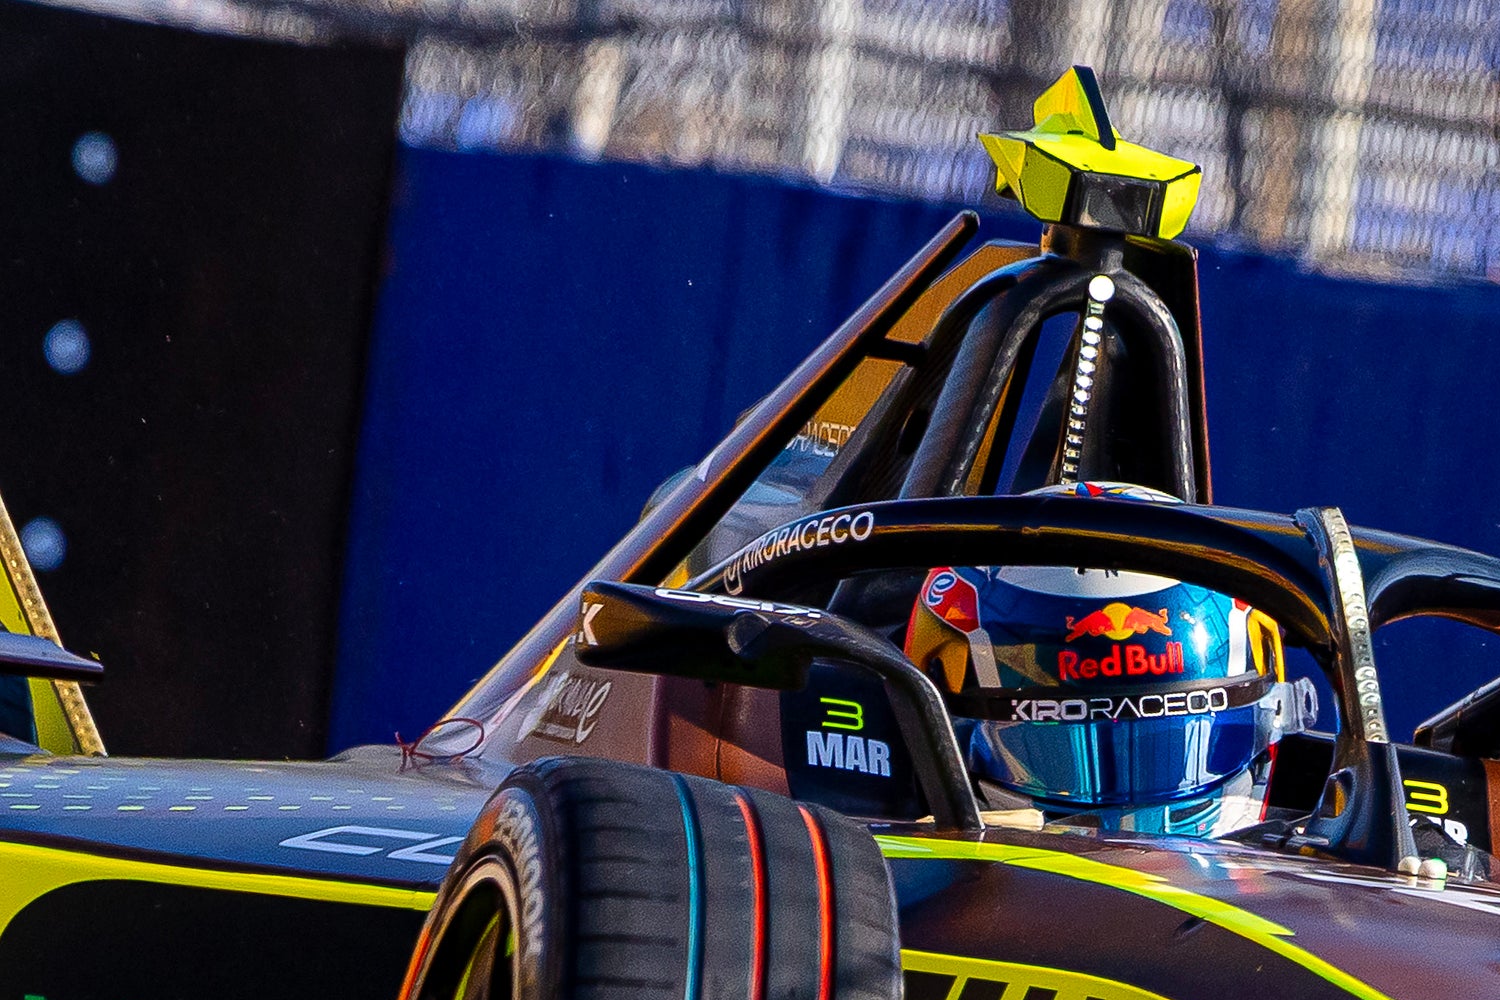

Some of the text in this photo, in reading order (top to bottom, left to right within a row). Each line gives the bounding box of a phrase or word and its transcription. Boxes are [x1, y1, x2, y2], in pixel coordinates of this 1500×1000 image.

[1057, 641, 1185, 680] Red Bull
[819, 697, 864, 731] 3
[806, 731, 891, 777] MAR
[1403, 779, 1449, 815] 3
